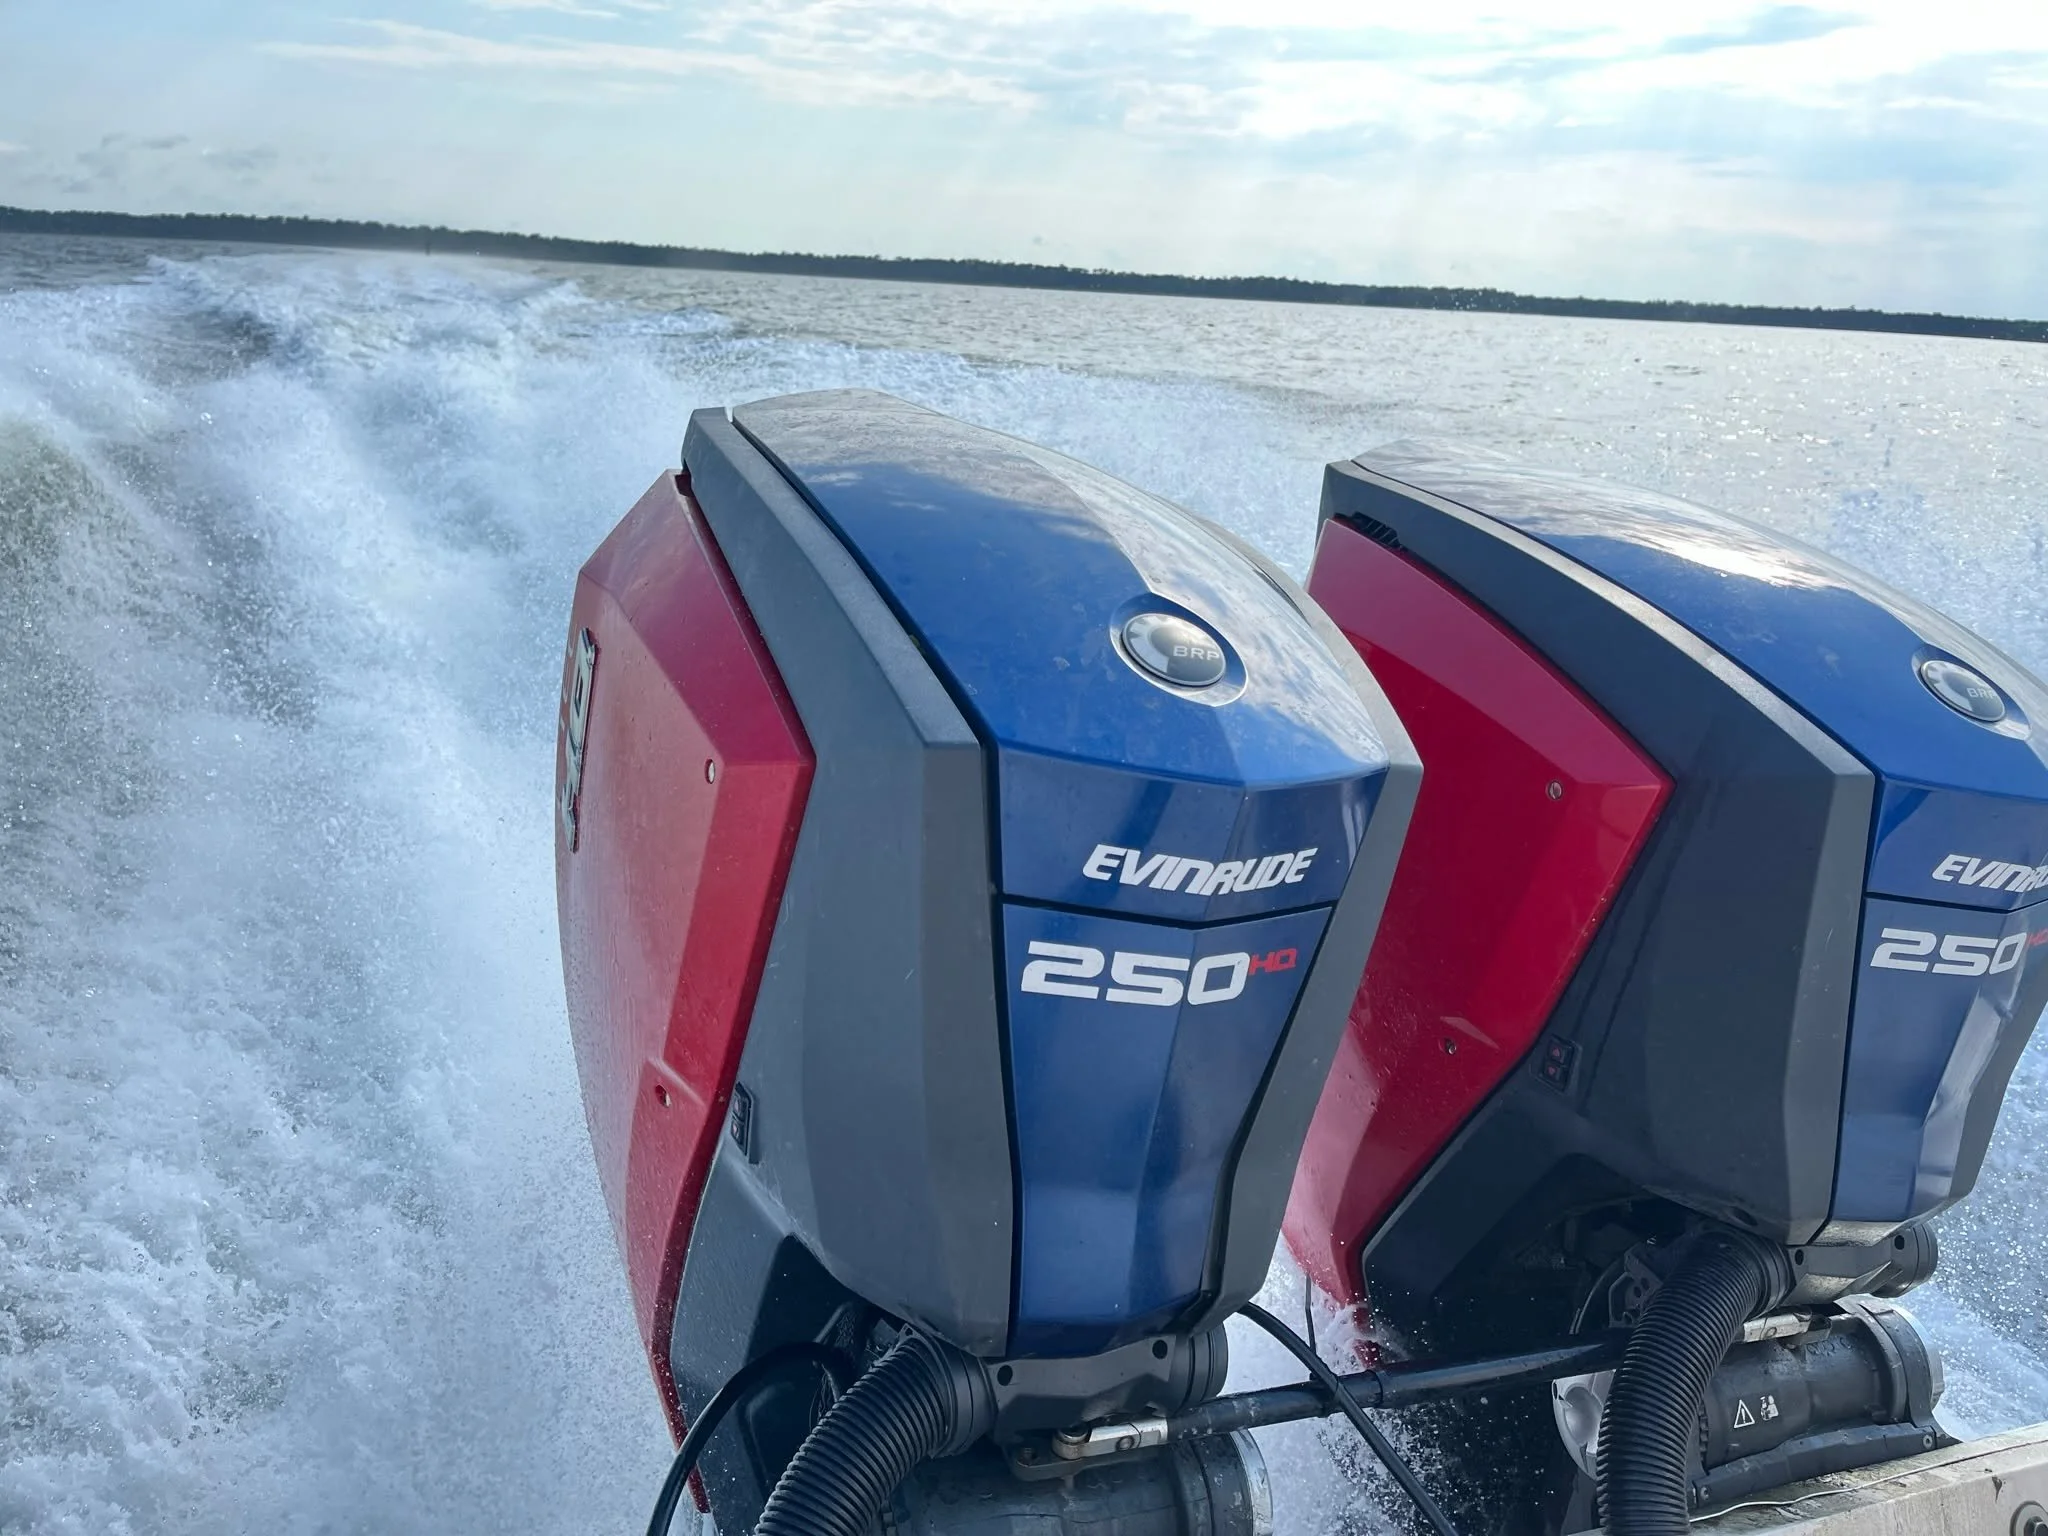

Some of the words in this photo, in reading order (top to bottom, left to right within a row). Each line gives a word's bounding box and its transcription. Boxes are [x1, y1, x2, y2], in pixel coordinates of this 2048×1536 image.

[1172, 645, 1220, 661] BRP
[1083, 844, 1318, 896] EVINRUDE
[1021, 941, 1250, 1006] 250
[1870, 927, 2028, 977] 250
